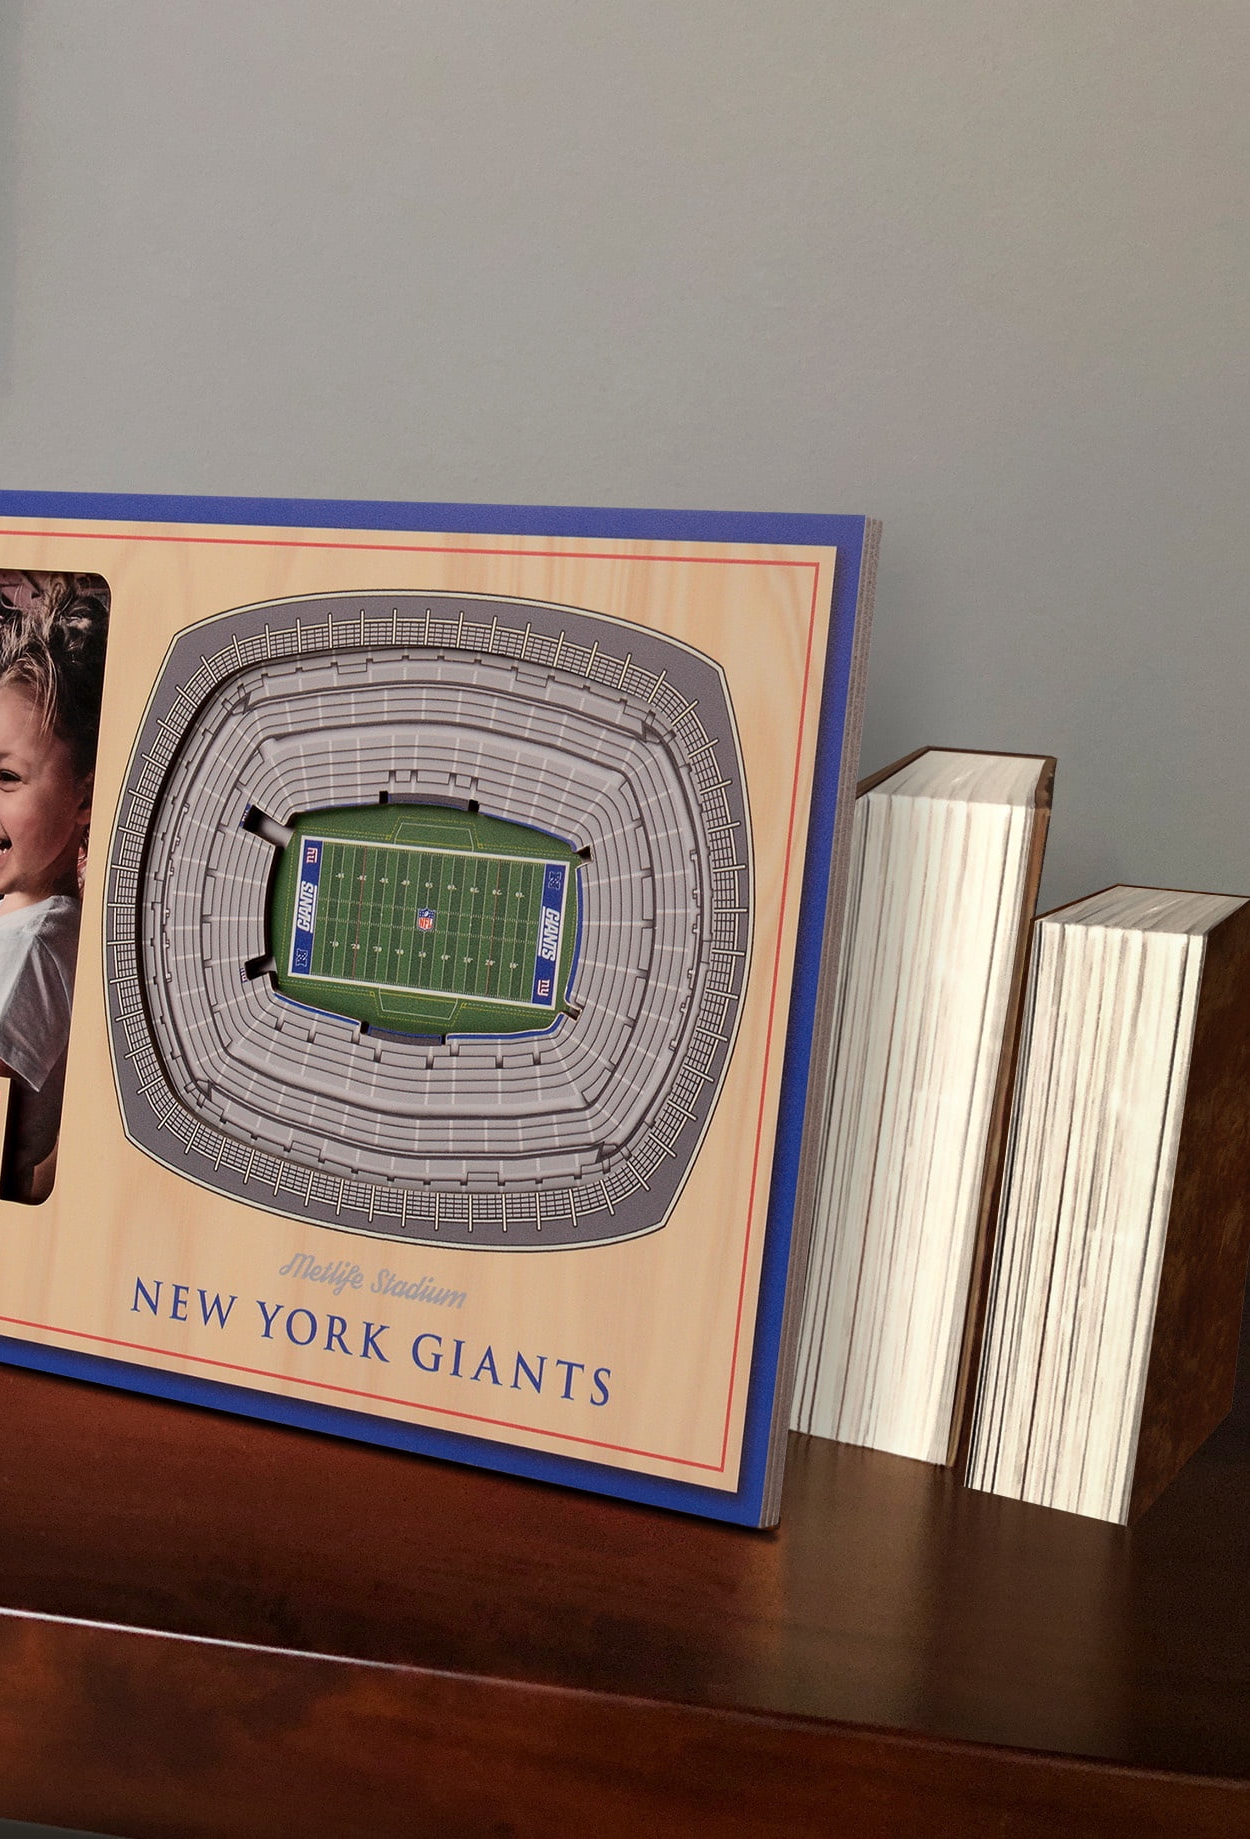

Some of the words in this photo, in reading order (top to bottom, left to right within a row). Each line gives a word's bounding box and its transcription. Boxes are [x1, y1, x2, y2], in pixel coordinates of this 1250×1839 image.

[297, 880, 316, 934] GIANTS
[418, 917, 434, 930] NFL
[539, 906, 560, 962] GIANTS
[370, 1268, 468, 1309] Stadium
[130, 1276, 238, 1330] NEW
[256, 1299, 391, 1363] YORK
[411, 1332, 612, 1407] GIANTS
